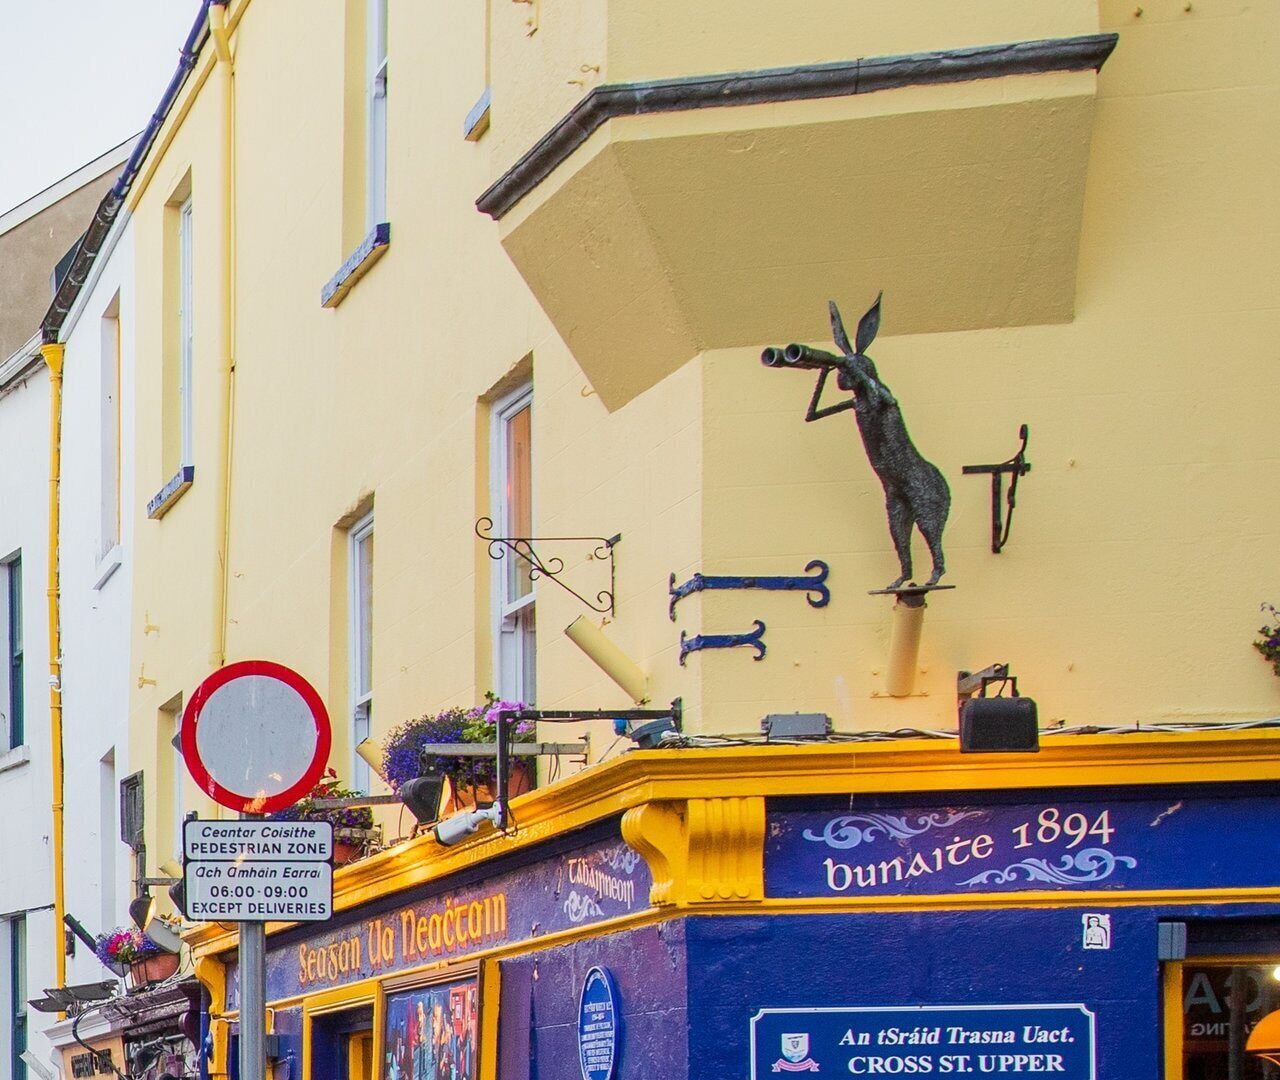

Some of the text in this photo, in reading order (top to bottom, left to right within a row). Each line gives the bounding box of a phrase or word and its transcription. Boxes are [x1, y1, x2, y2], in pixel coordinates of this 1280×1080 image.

[202, 826, 316, 838] Ceantar Coisithe
[1012, 807, 1115, 849] 1894
[191, 843, 326, 854] PEDESTRIAN ZONE
[192, 903, 326, 914] EXCEPT DELIVERIES
[838, 1025, 1075, 1046] An tSráid Trasna Uact.
[848, 1054, 1065, 1075] CROSS ST. UPPER
